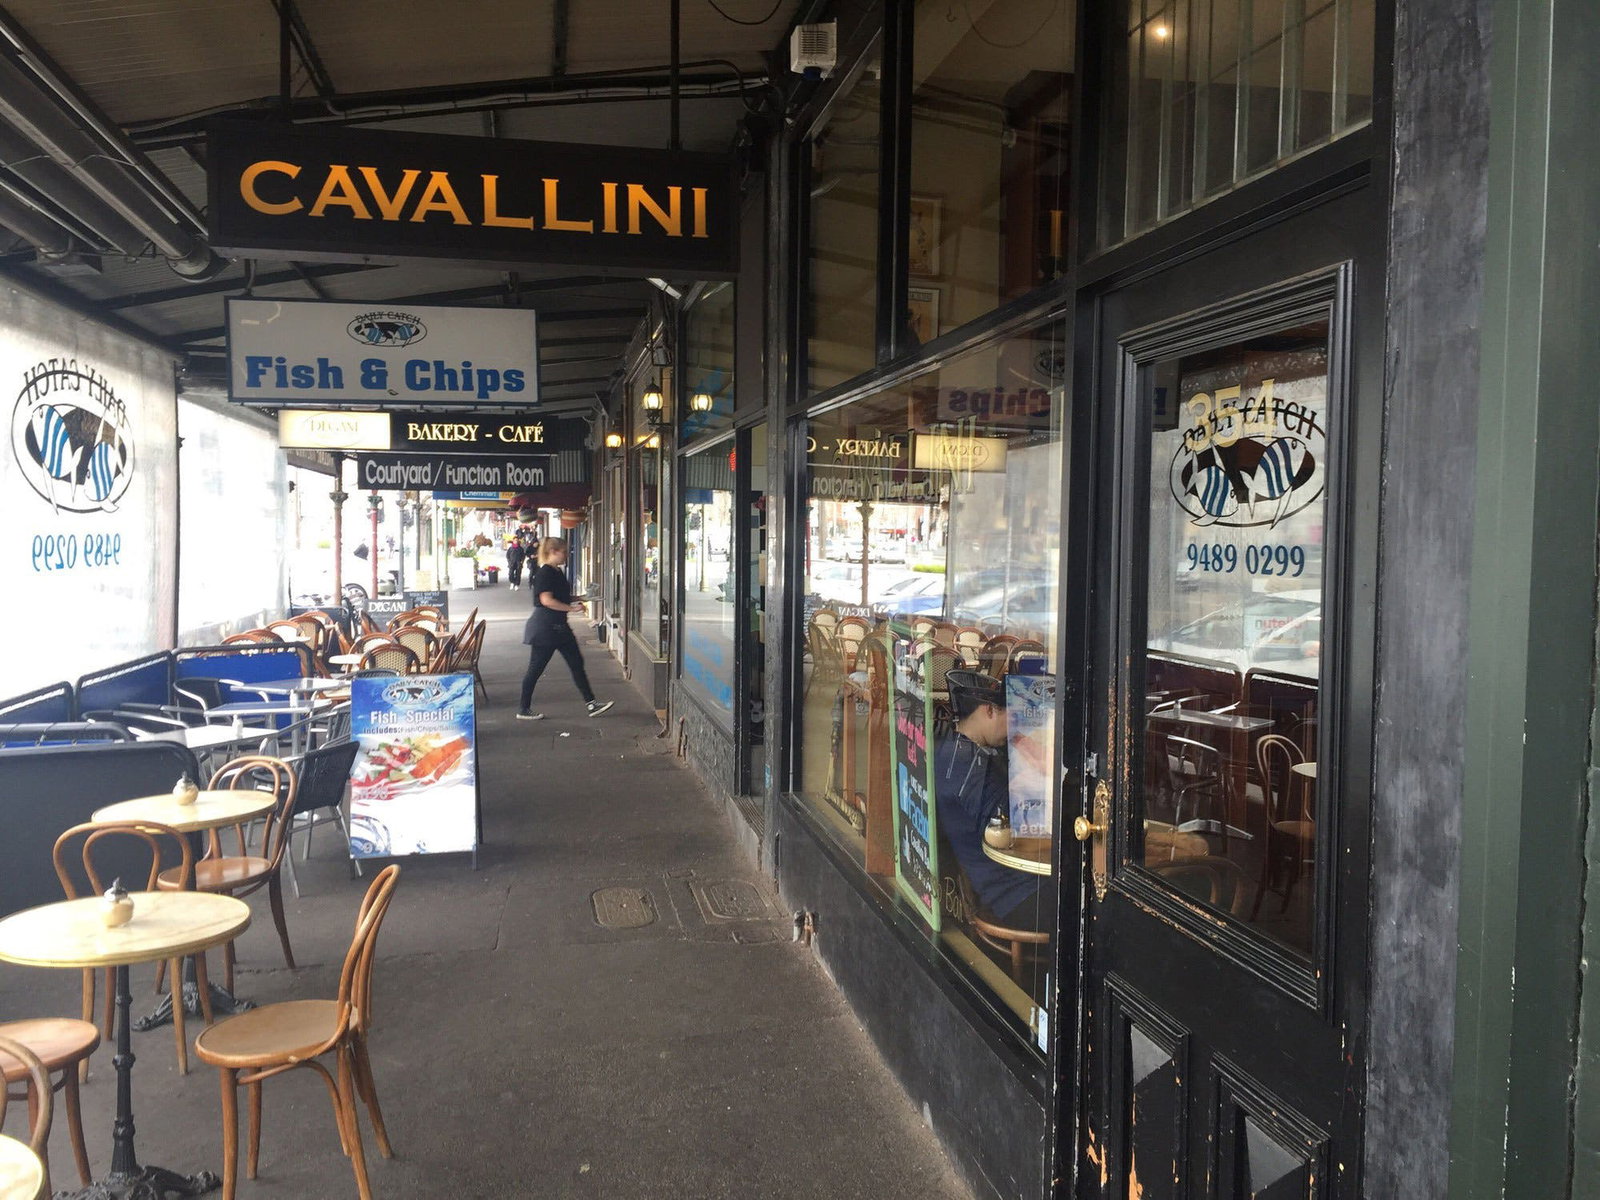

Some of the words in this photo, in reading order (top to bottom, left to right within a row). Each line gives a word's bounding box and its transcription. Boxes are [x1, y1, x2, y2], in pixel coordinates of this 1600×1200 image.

[240, 160, 709, 239] CAVALLINI
[387, 311, 421, 325] CATCH
[246, 356, 344, 390] Fish
[360, 358, 388, 391] &
[405, 361, 525, 399] Chips
[1187, 378, 1275, 452] 354
[407, 423, 479, 442] BAKERY
[499, 421, 544, 443] CAFÉ
[365, 460, 431, 489] Courtyard
[446, 464, 500, 486] Function
[506, 463, 544, 487] Room
[1187, 543, 1238, 573] 9489
[1245, 544, 1305, 578] 0299
[370, 711, 397, 725] Fish
[406, 708, 454, 724] Special
